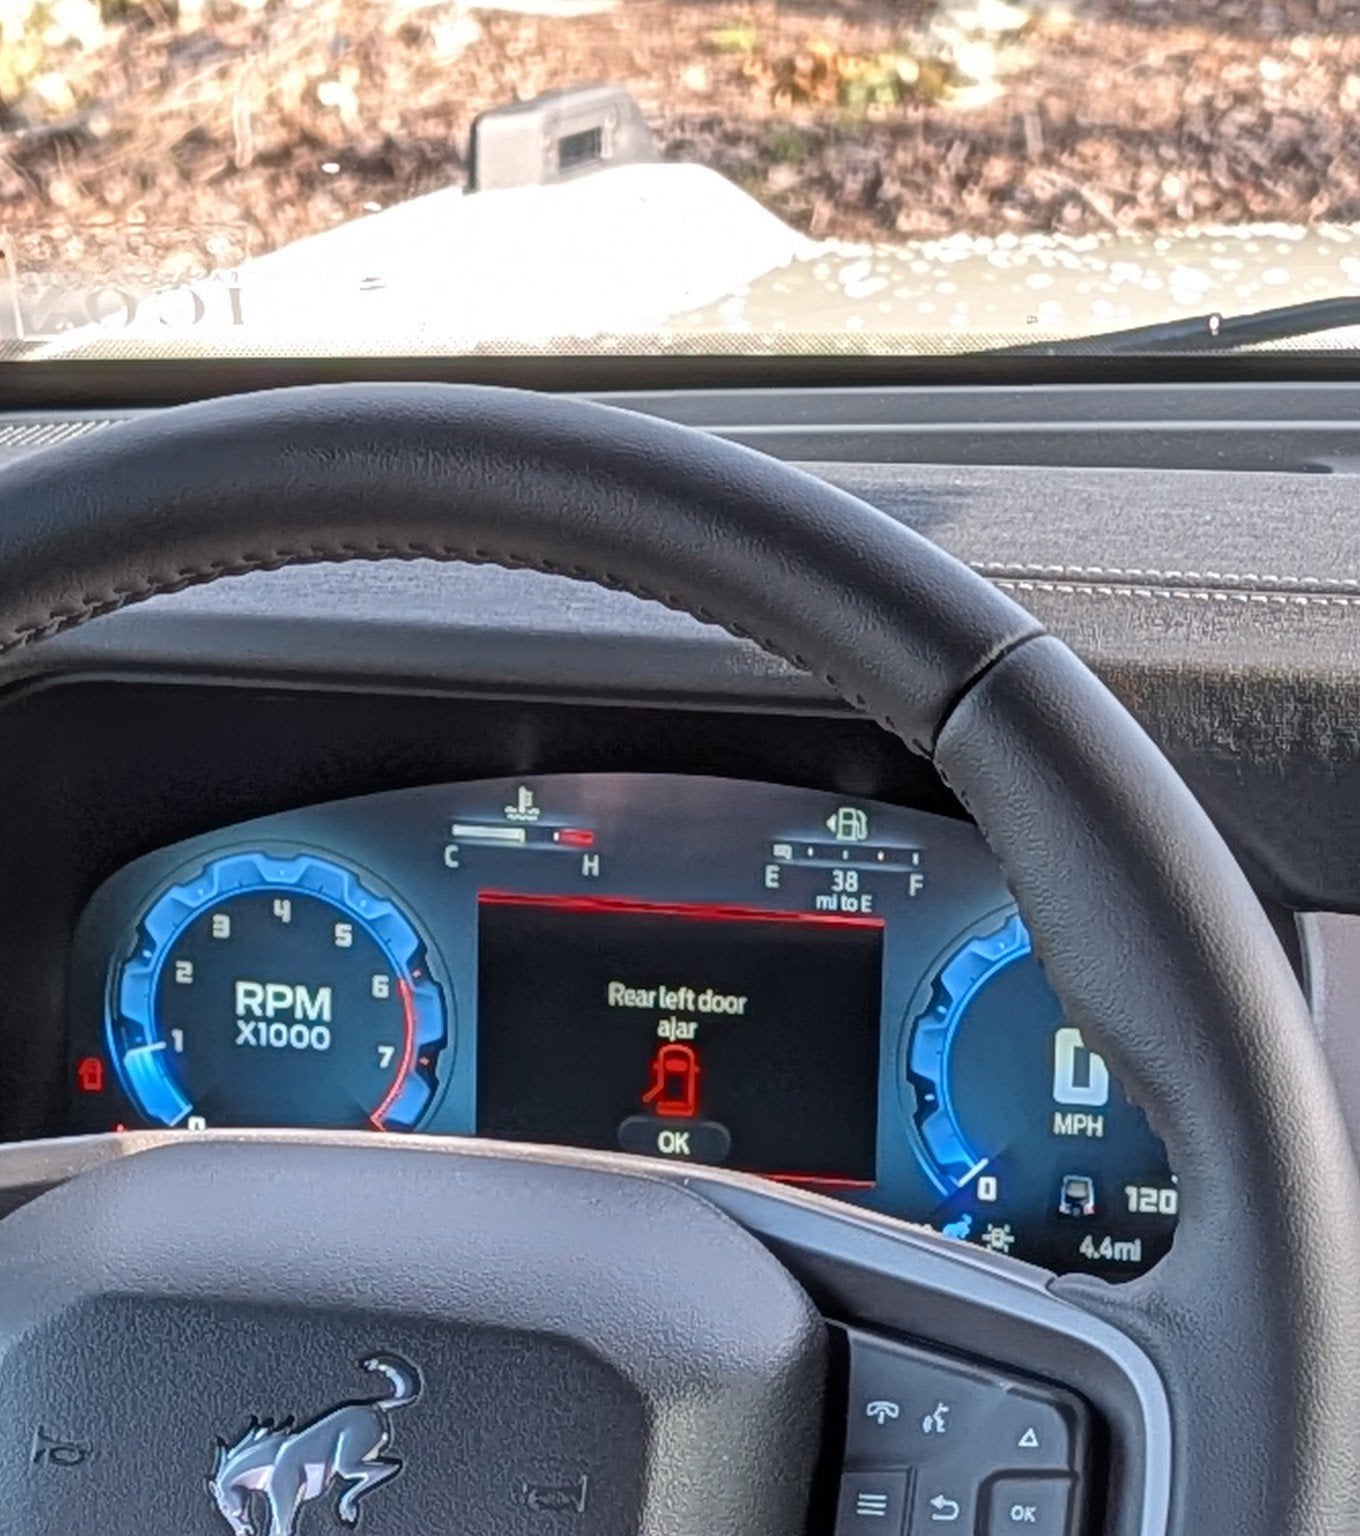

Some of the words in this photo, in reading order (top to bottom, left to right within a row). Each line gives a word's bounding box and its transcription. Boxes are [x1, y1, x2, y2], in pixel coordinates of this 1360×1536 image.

[444, 845, 459, 868] C
[582, 855, 599, 877] H
[765, 864, 780, 888] E
[831, 869, 859, 892] 38
[909, 873, 924, 897] F
[273, 899, 291, 922] 4
[816, 894, 837, 910] mi
[840, 894, 858, 912] to
[861, 895, 872, 913] E
[212, 914, 230, 938] 3
[335, 923, 353, 947] 5
[175, 961, 193, 984] 2
[372, 975, 389, 998] 6
[608, 981, 657, 1008] Rear
[658, 985, 695, 1012] left
[697, 989, 748, 1015] door
[235, 980, 332, 1022] RPM
[171, 1028, 184, 1052] 1
[235, 1020, 331, 1050] X1000
[656, 1016, 699, 1042] ajar
[377, 1046, 395, 1068] 7
[1053, 1112, 1104, 1137] MPH
[657, 1131, 690, 1154] OK
[977, 1177, 997, 1201] 0
[1124, 1185, 1178, 1214] 120
[1010, 1505, 1038, 1522] OK
